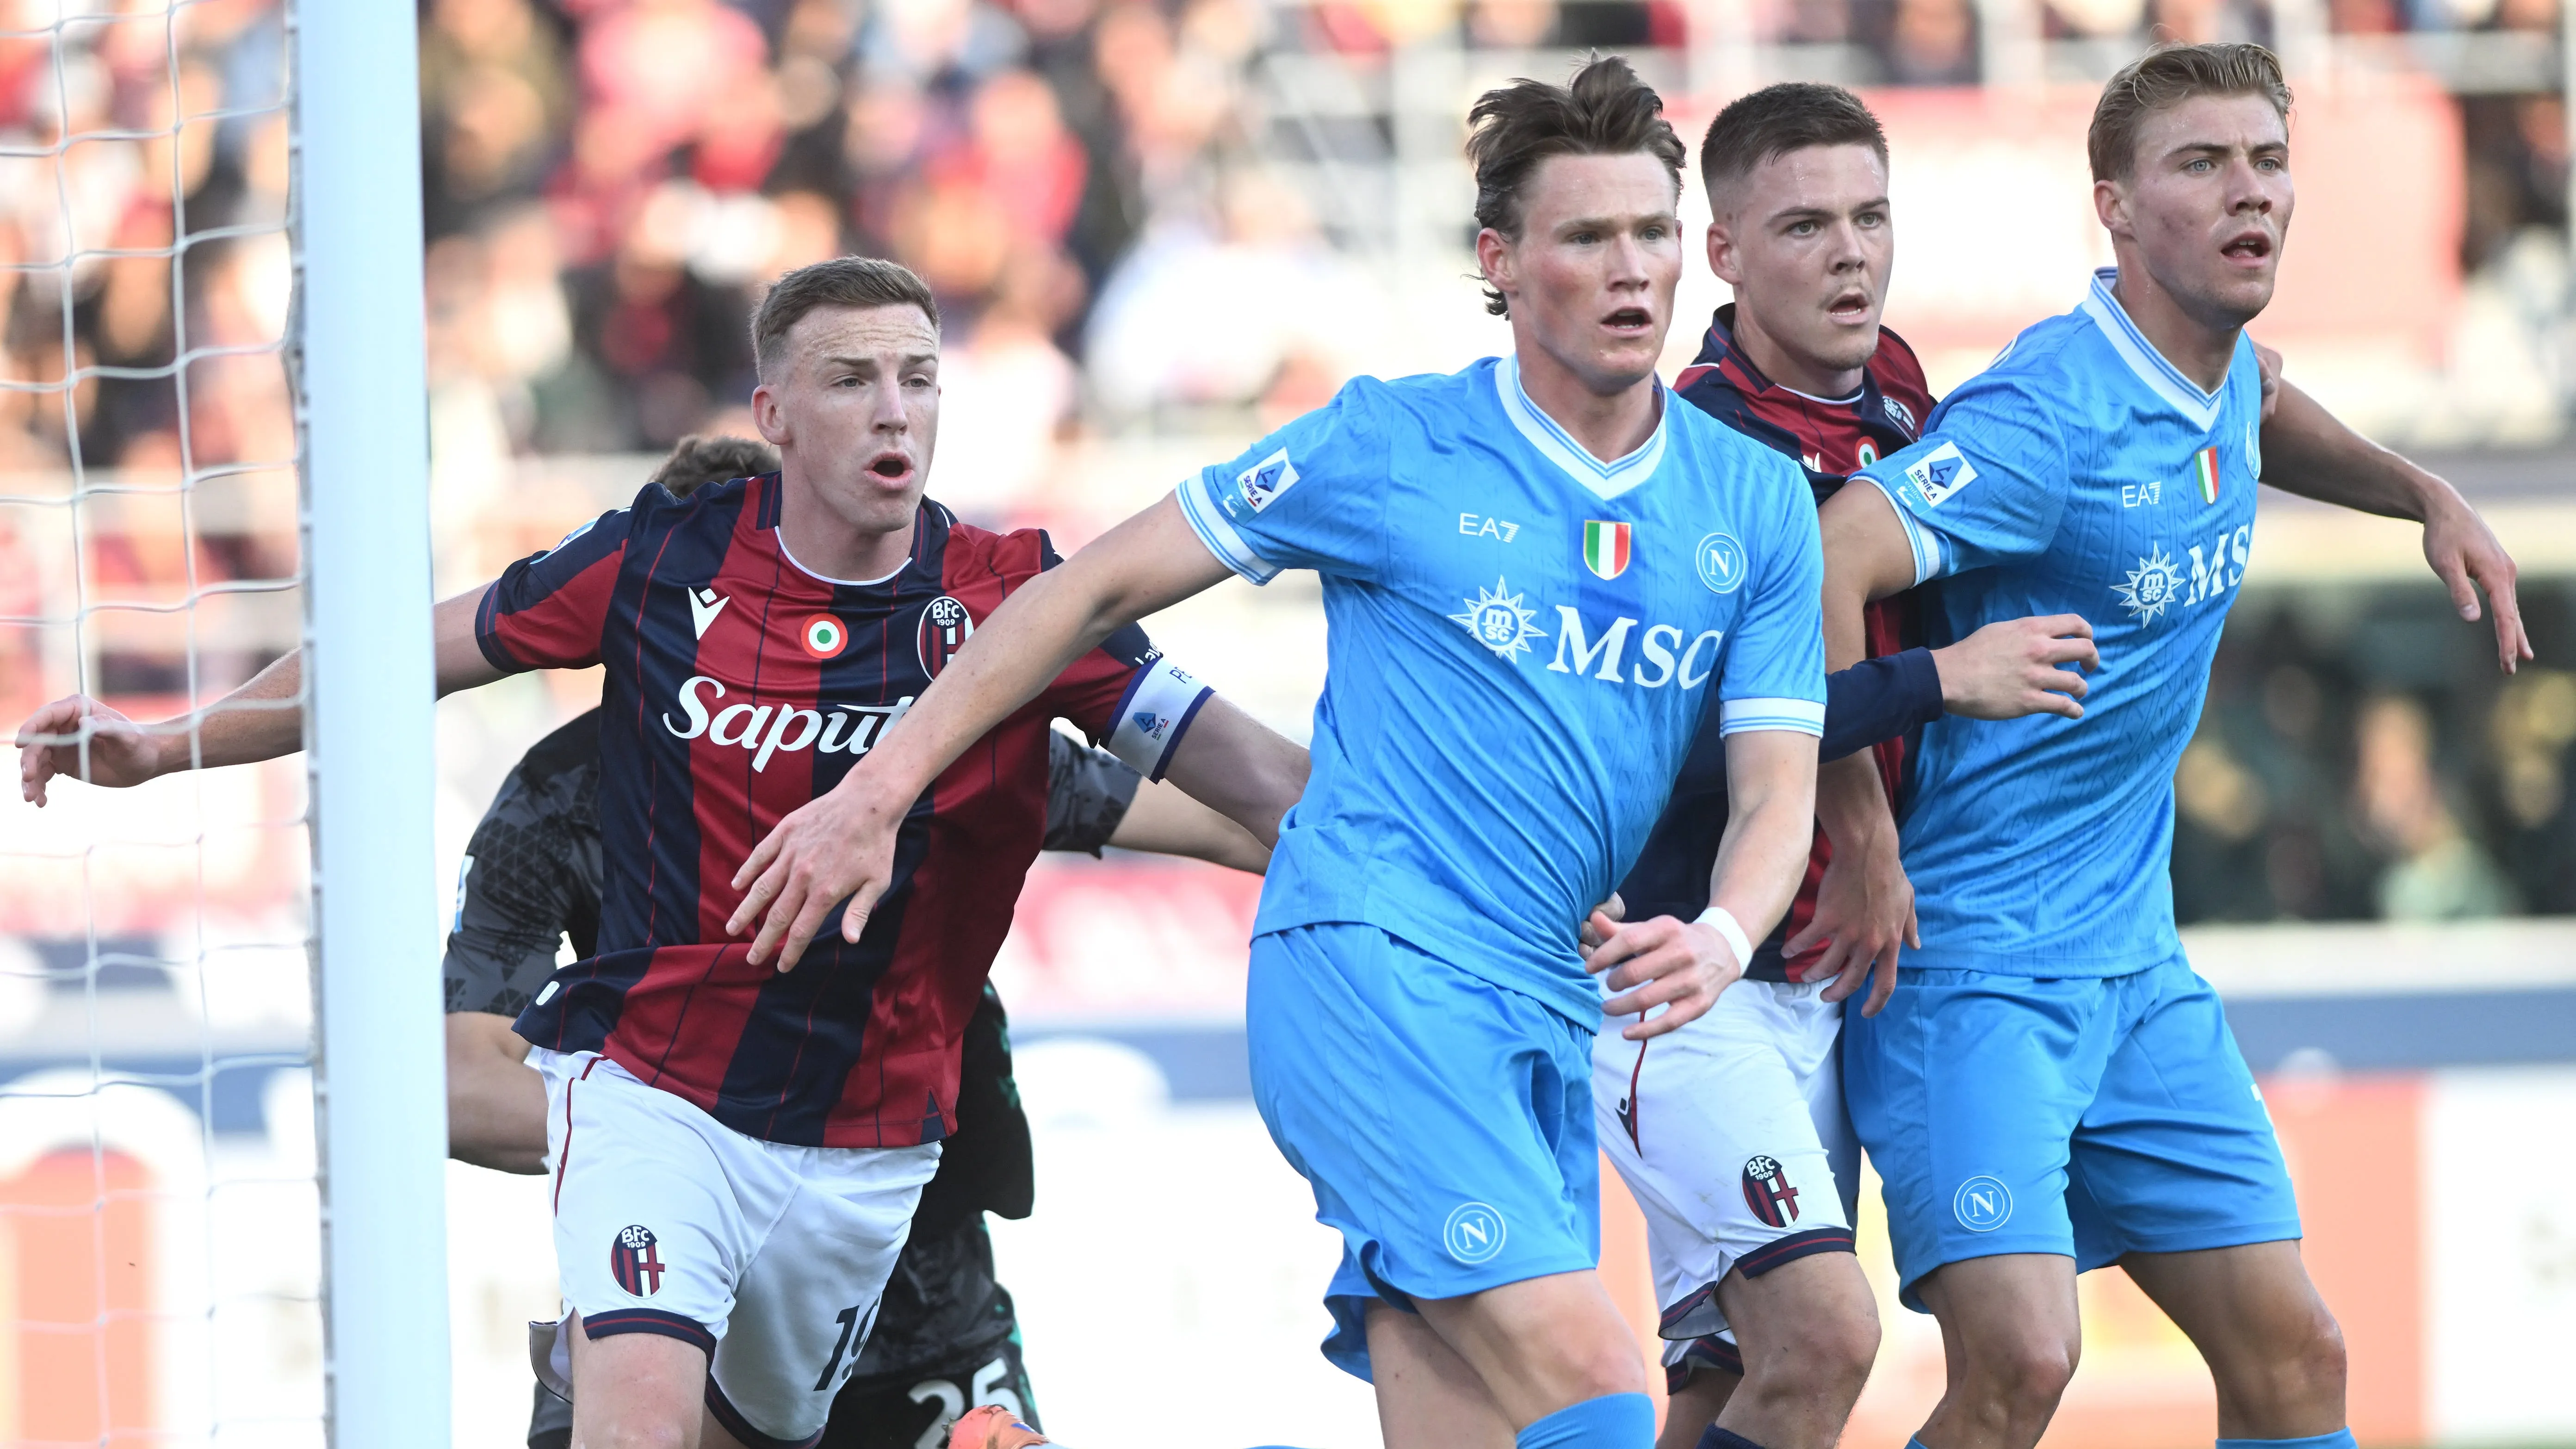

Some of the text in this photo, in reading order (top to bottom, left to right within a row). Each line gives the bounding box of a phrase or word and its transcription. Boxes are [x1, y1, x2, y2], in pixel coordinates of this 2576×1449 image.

[1243, 475, 1258, 498] SERIE
[1914, 469, 1933, 492] SERIE
[2122, 482, 2161, 508] EA7
[1459, 512, 1520, 543] EA7
[1709, 549, 1730, 577] N
[2184, 522, 2252, 607] MS
[932, 600, 960, 619] BFC
[1546, 604, 1724, 689] MSC
[662, 676, 915, 773] Saput
[1152, 722, 1163, 739] SERIE
[1746, 1157, 1775, 1177] BFC
[1755, 1170, 1773, 1180] 1909
[1970, 1190, 1995, 1218] N
[621, 1226, 650, 1244] BFC
[1461, 1217, 1488, 1250] N
[813, 1295, 880, 1391] 19
[907, 1357, 1024, 1449] 25
